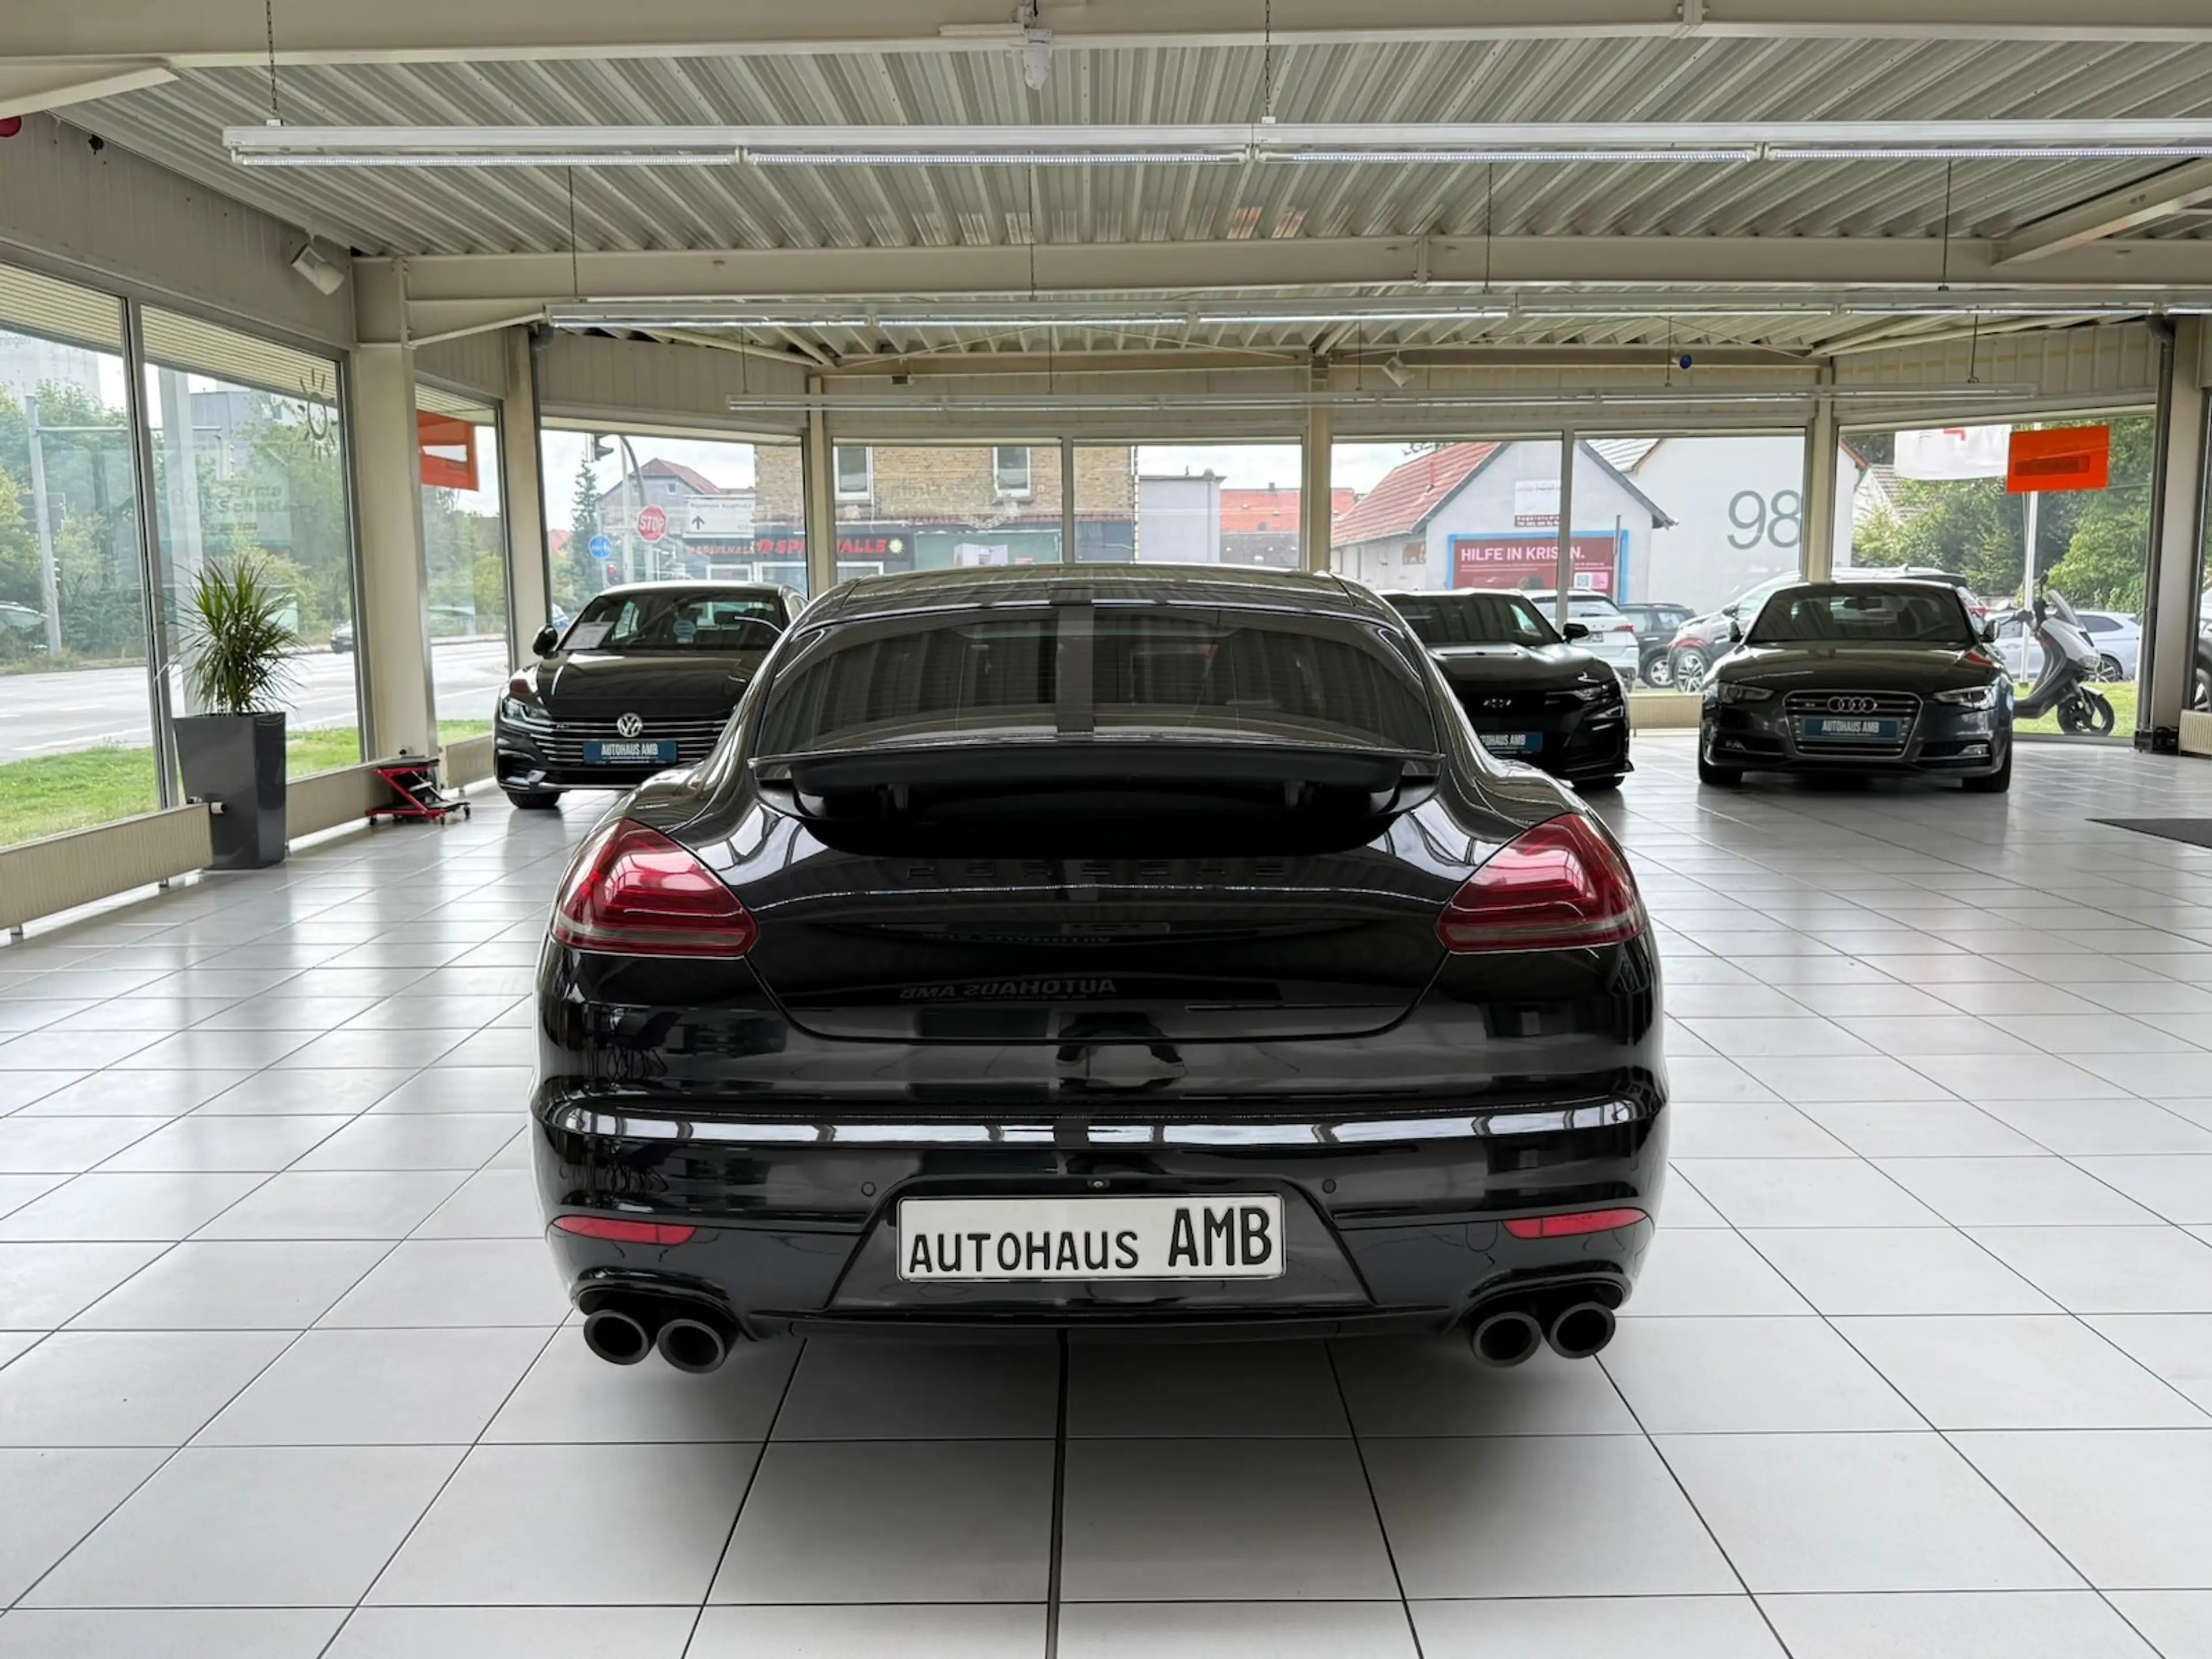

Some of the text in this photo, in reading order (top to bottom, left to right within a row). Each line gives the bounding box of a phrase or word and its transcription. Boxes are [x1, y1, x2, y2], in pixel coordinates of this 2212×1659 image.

[639, 516, 665, 532] STOP
[1727, 490, 1801, 550] 98
[1461, 546, 1585, 561] HILFE IN KRISN.
[1821, 719, 1880, 733] AUTOHAUS AMB
[1509, 734, 1527, 745] AMB
[601, 743, 659, 756] AUTOHAUS AMB
[909, 1206, 1272, 1272] AUTOHAUS AMB
